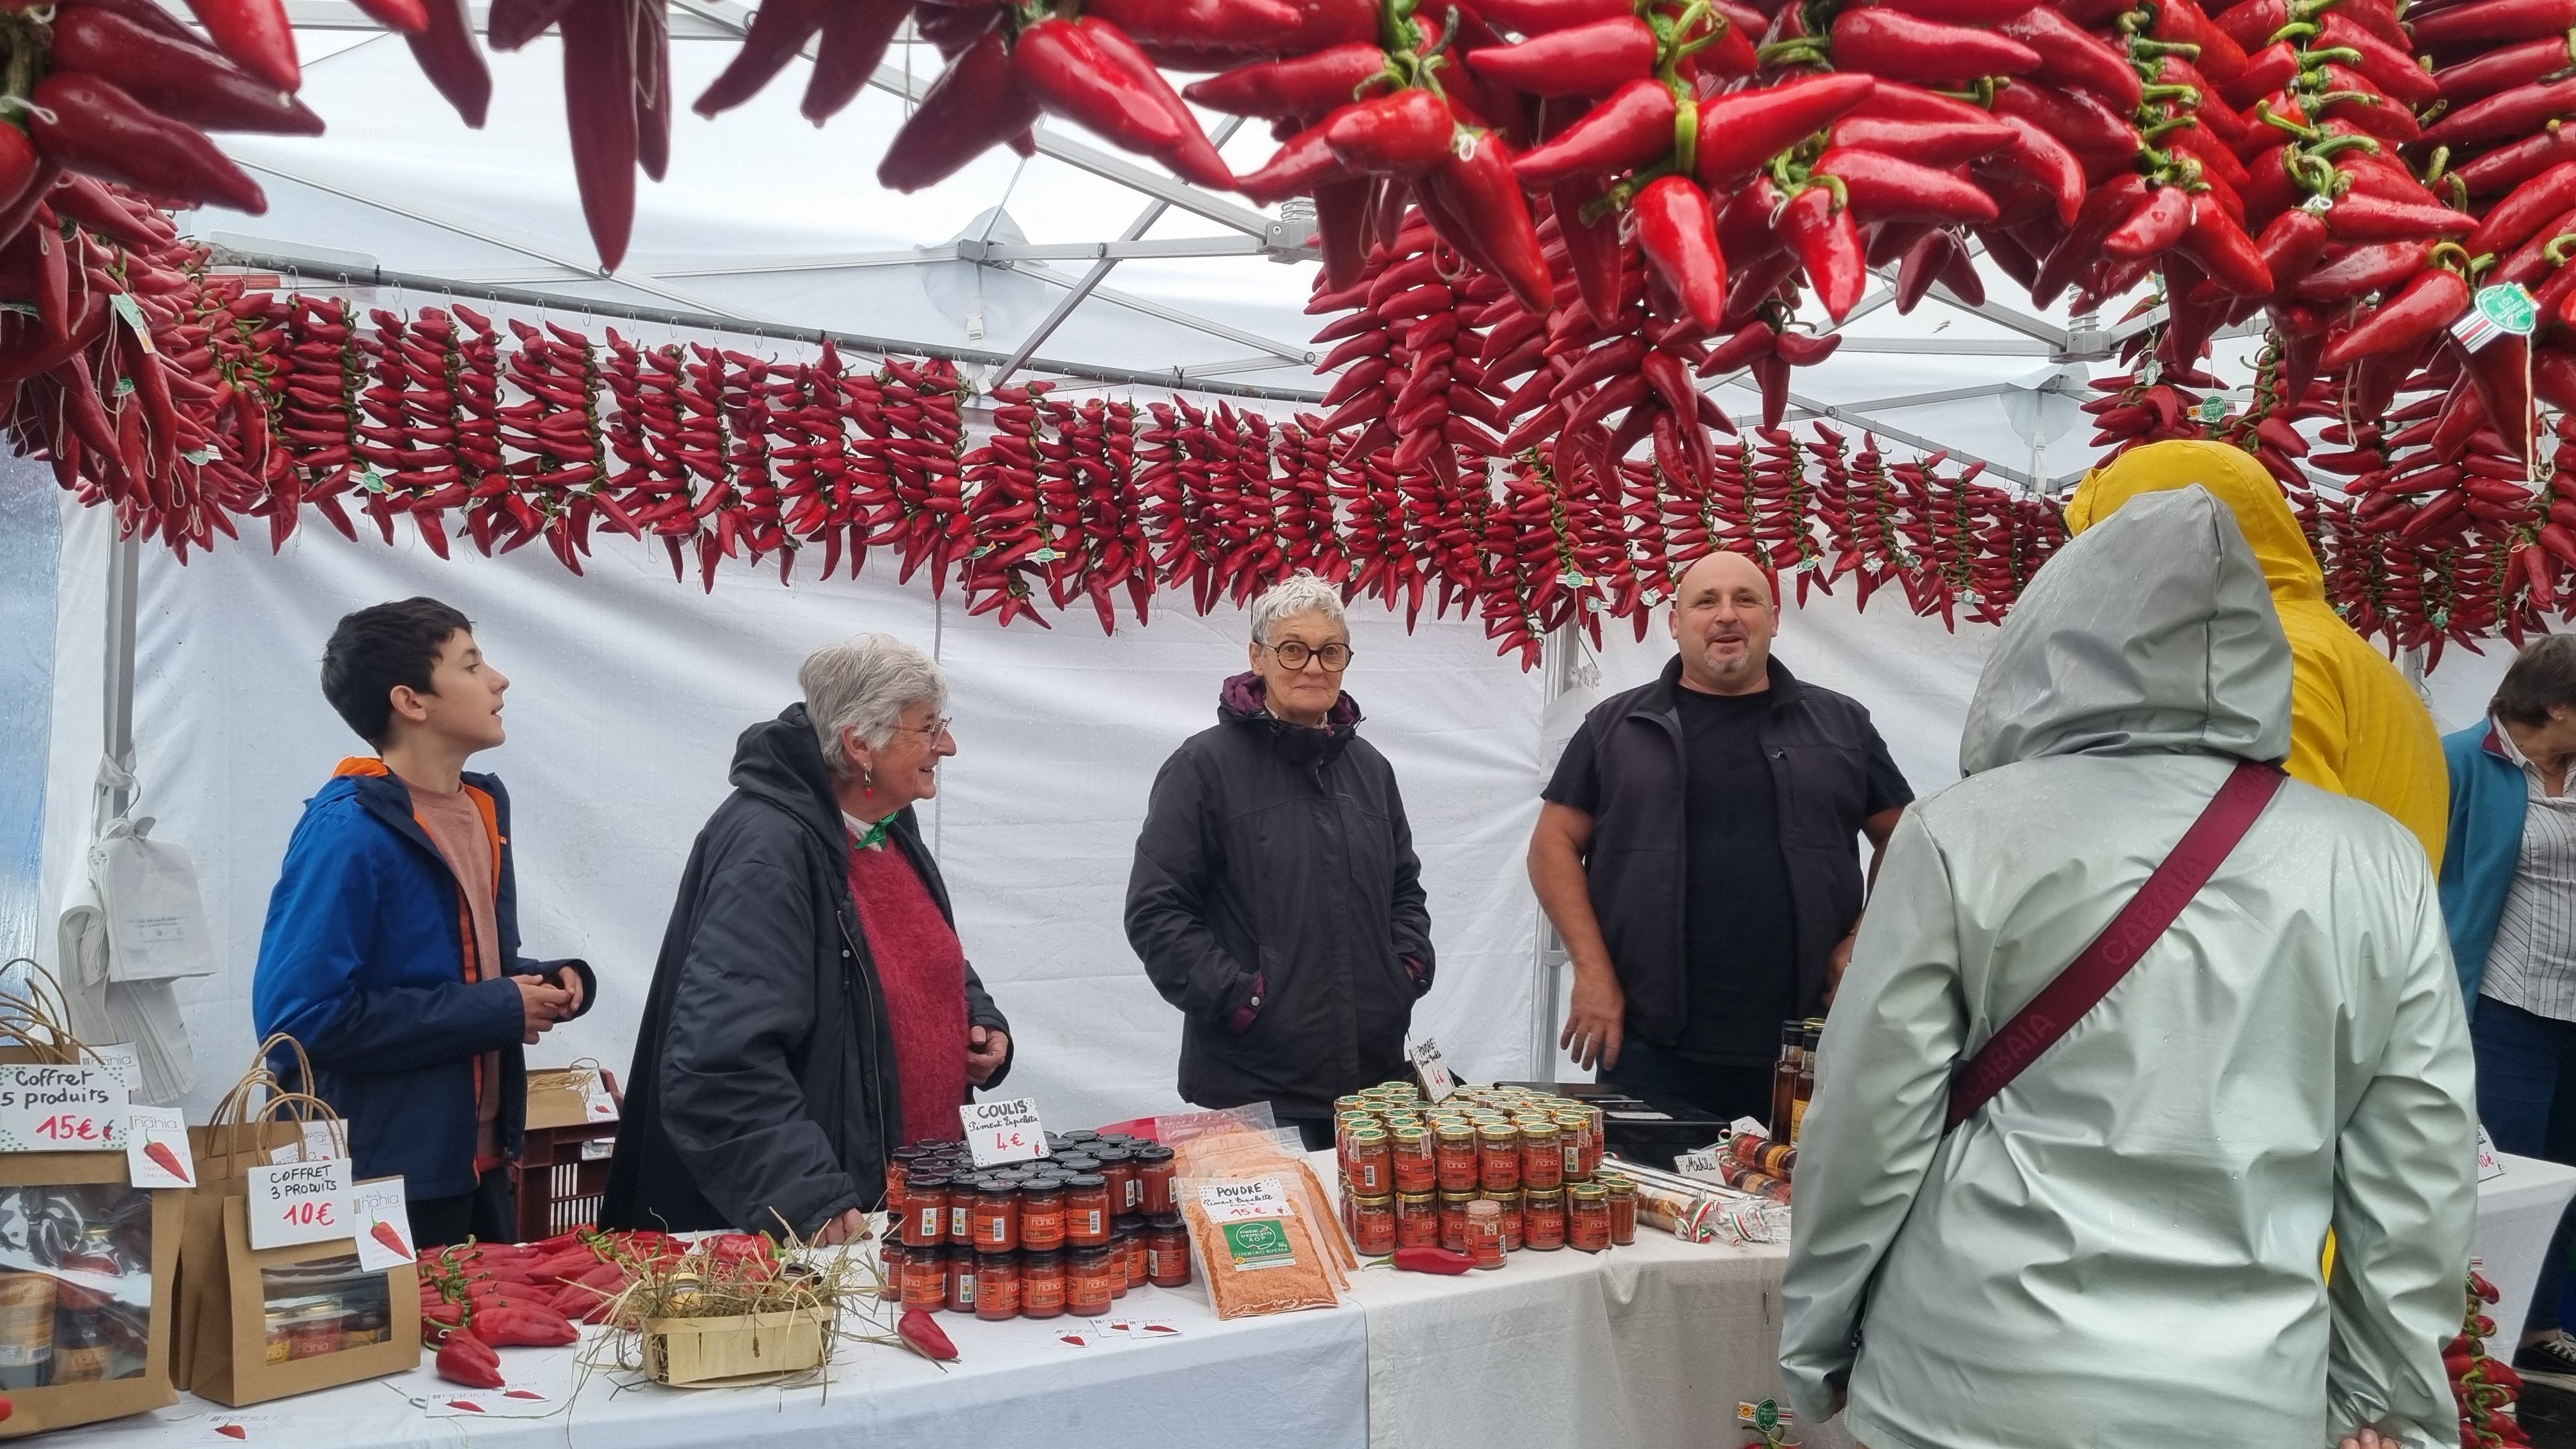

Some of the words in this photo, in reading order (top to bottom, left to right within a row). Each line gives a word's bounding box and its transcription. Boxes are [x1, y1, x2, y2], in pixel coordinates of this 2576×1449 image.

[2102, 855, 2204, 965] CABAIA
[15, 1068, 93, 1086] Coffret
[1, 1092, 15, 1106] 5
[24, 1088, 109, 1109] produits
[977, 1100, 1027, 1119] COULIS
[135, 1117, 177, 1129] nahia
[969, 1121, 1002, 1131] Piment
[1444, 1160, 1466, 1169] nahia
[1491, 1160, 1513, 1169] nahia
[1536, 1158, 1557, 1167] nahia
[270, 1165, 332, 1183] COFFRET
[271, 1186, 280, 1199] 3
[1216, 1183, 1262, 1197] POUDRE
[362, 1190, 399, 1209] nahia
[283, 1202, 335, 1225] 10€
[1031, 1217, 1054, 1226] nahia
[1542, 1219, 1561, 1227] nahia
[1372, 1223, 1392, 1233] nahia
[1038, 1282, 1061, 1291] nahia
[1087, 1278, 1108, 1288] nahia
